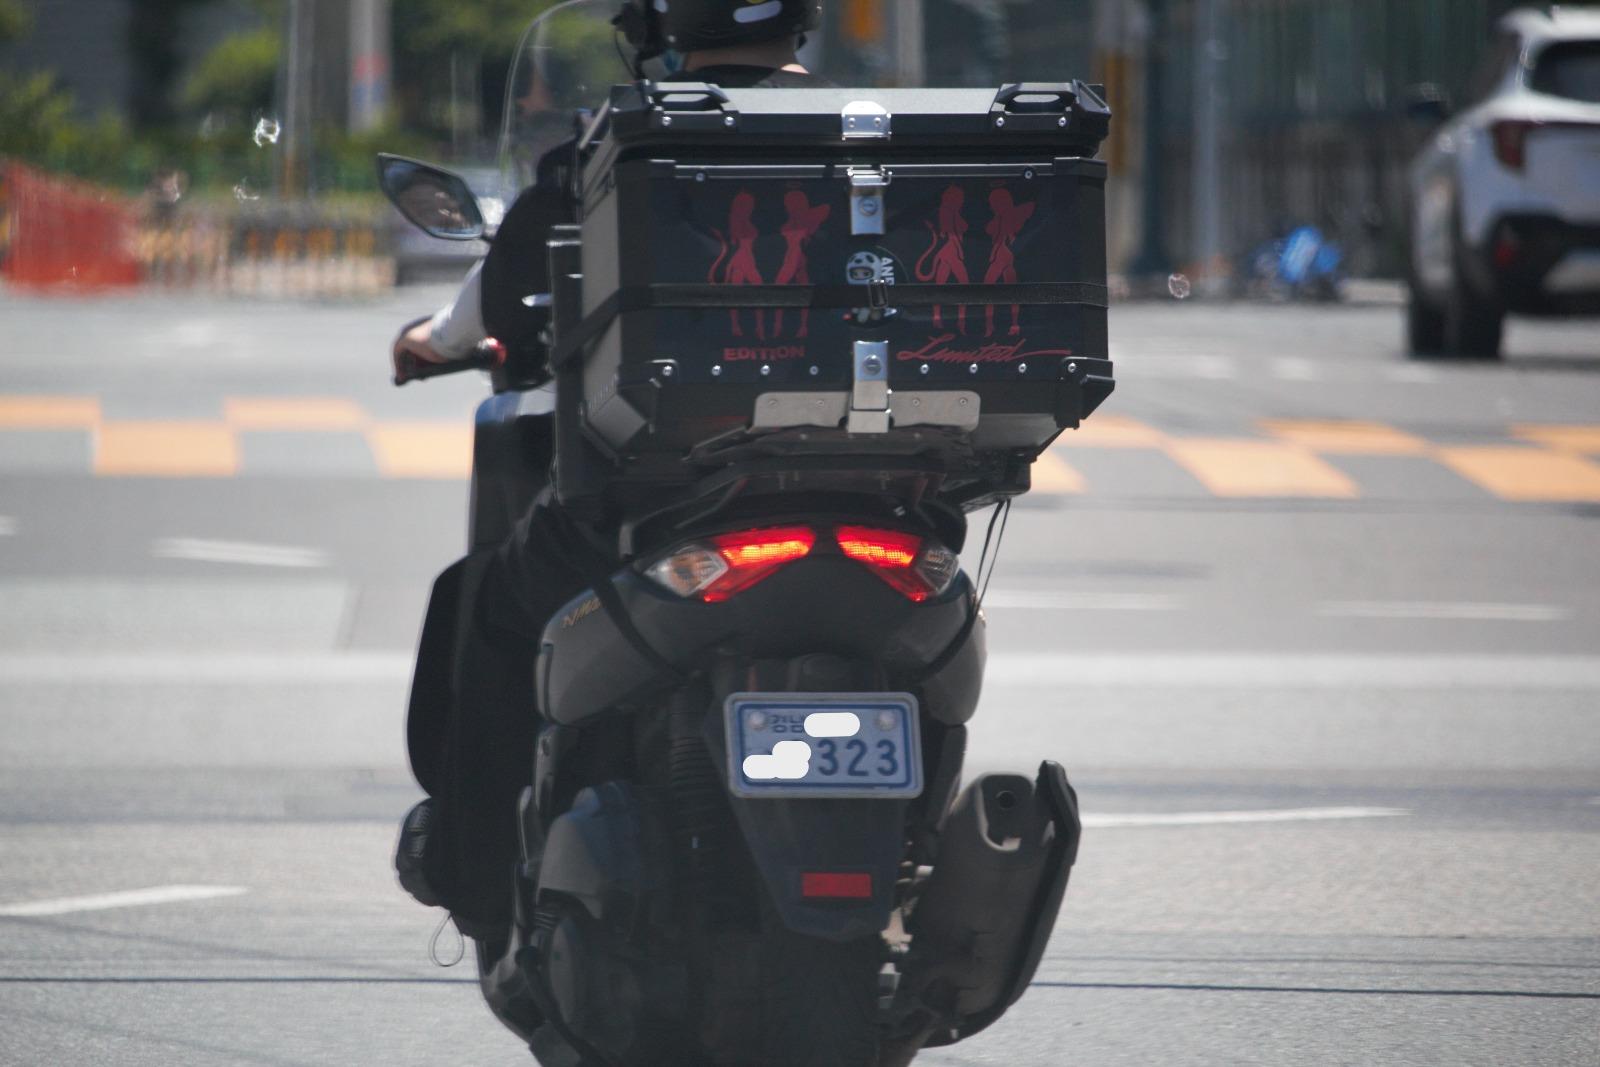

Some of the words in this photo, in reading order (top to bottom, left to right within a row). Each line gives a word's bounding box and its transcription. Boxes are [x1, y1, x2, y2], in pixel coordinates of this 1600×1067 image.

[723, 346, 805, 362] EDITION
[896, 333, 1073, 363] Limited
[790, 738, 898, 776] 323
